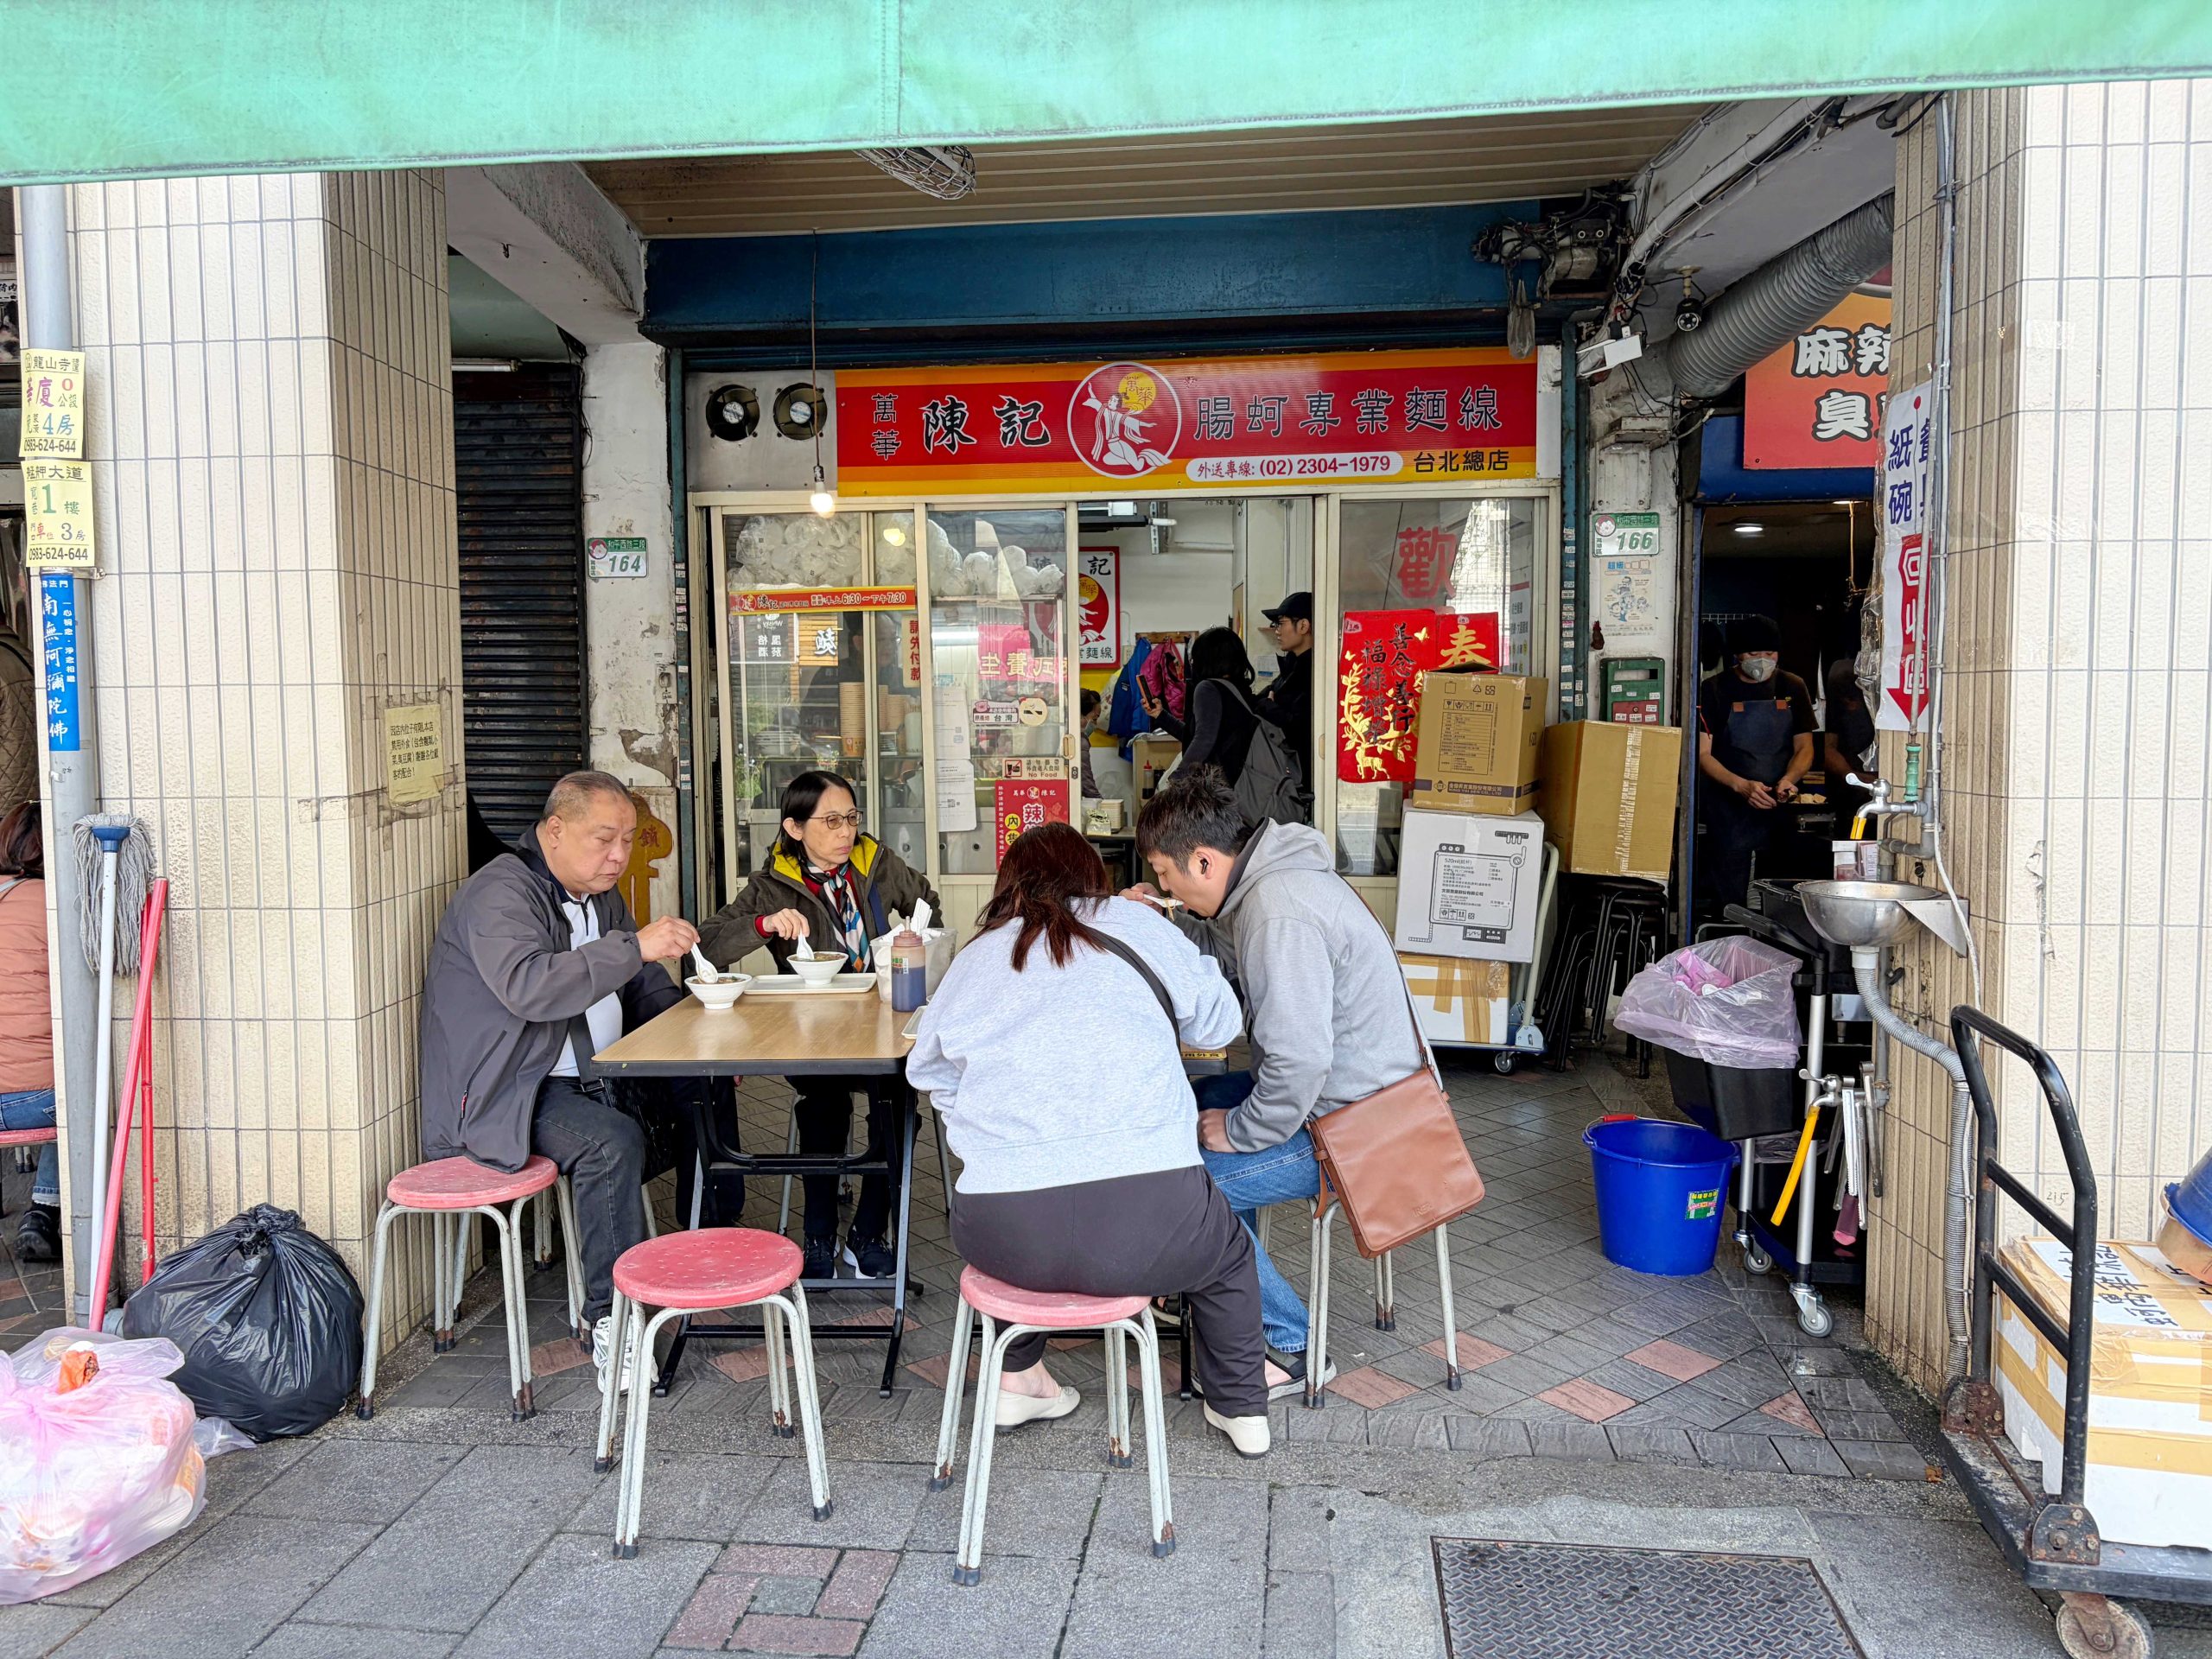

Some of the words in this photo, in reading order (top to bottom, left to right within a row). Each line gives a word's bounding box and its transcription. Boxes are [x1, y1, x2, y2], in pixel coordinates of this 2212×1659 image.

[33, 355, 71, 372] 龍山寺
[42, 412, 75, 435] 4房
[872, 393, 902, 461] 萬華
[918, 394, 1052, 456] 陳記
[1192, 384, 1503, 442] 腸蚵專業麵線
[26, 465, 84, 480] 艋舺大道
[1260, 459, 1294, 476] (02)
[1297, 454, 1392, 474] 2304-1979
[1413, 449, 1510, 474] 台北總店
[1888, 424, 1914, 525] 紙碗
[29, 547, 88, 561] 0983-624-644
[1617, 531, 1654, 550] 166
[608, 556, 642, 572] 164
[1397, 526, 1458, 599] 歡
[910, 620, 920, 681] 請先付款
[1438, 625, 1492, 668] 春
[42, 593, 69, 745] 南無阿彌陀佛
[1389, 622, 1417, 733] 善念善行
